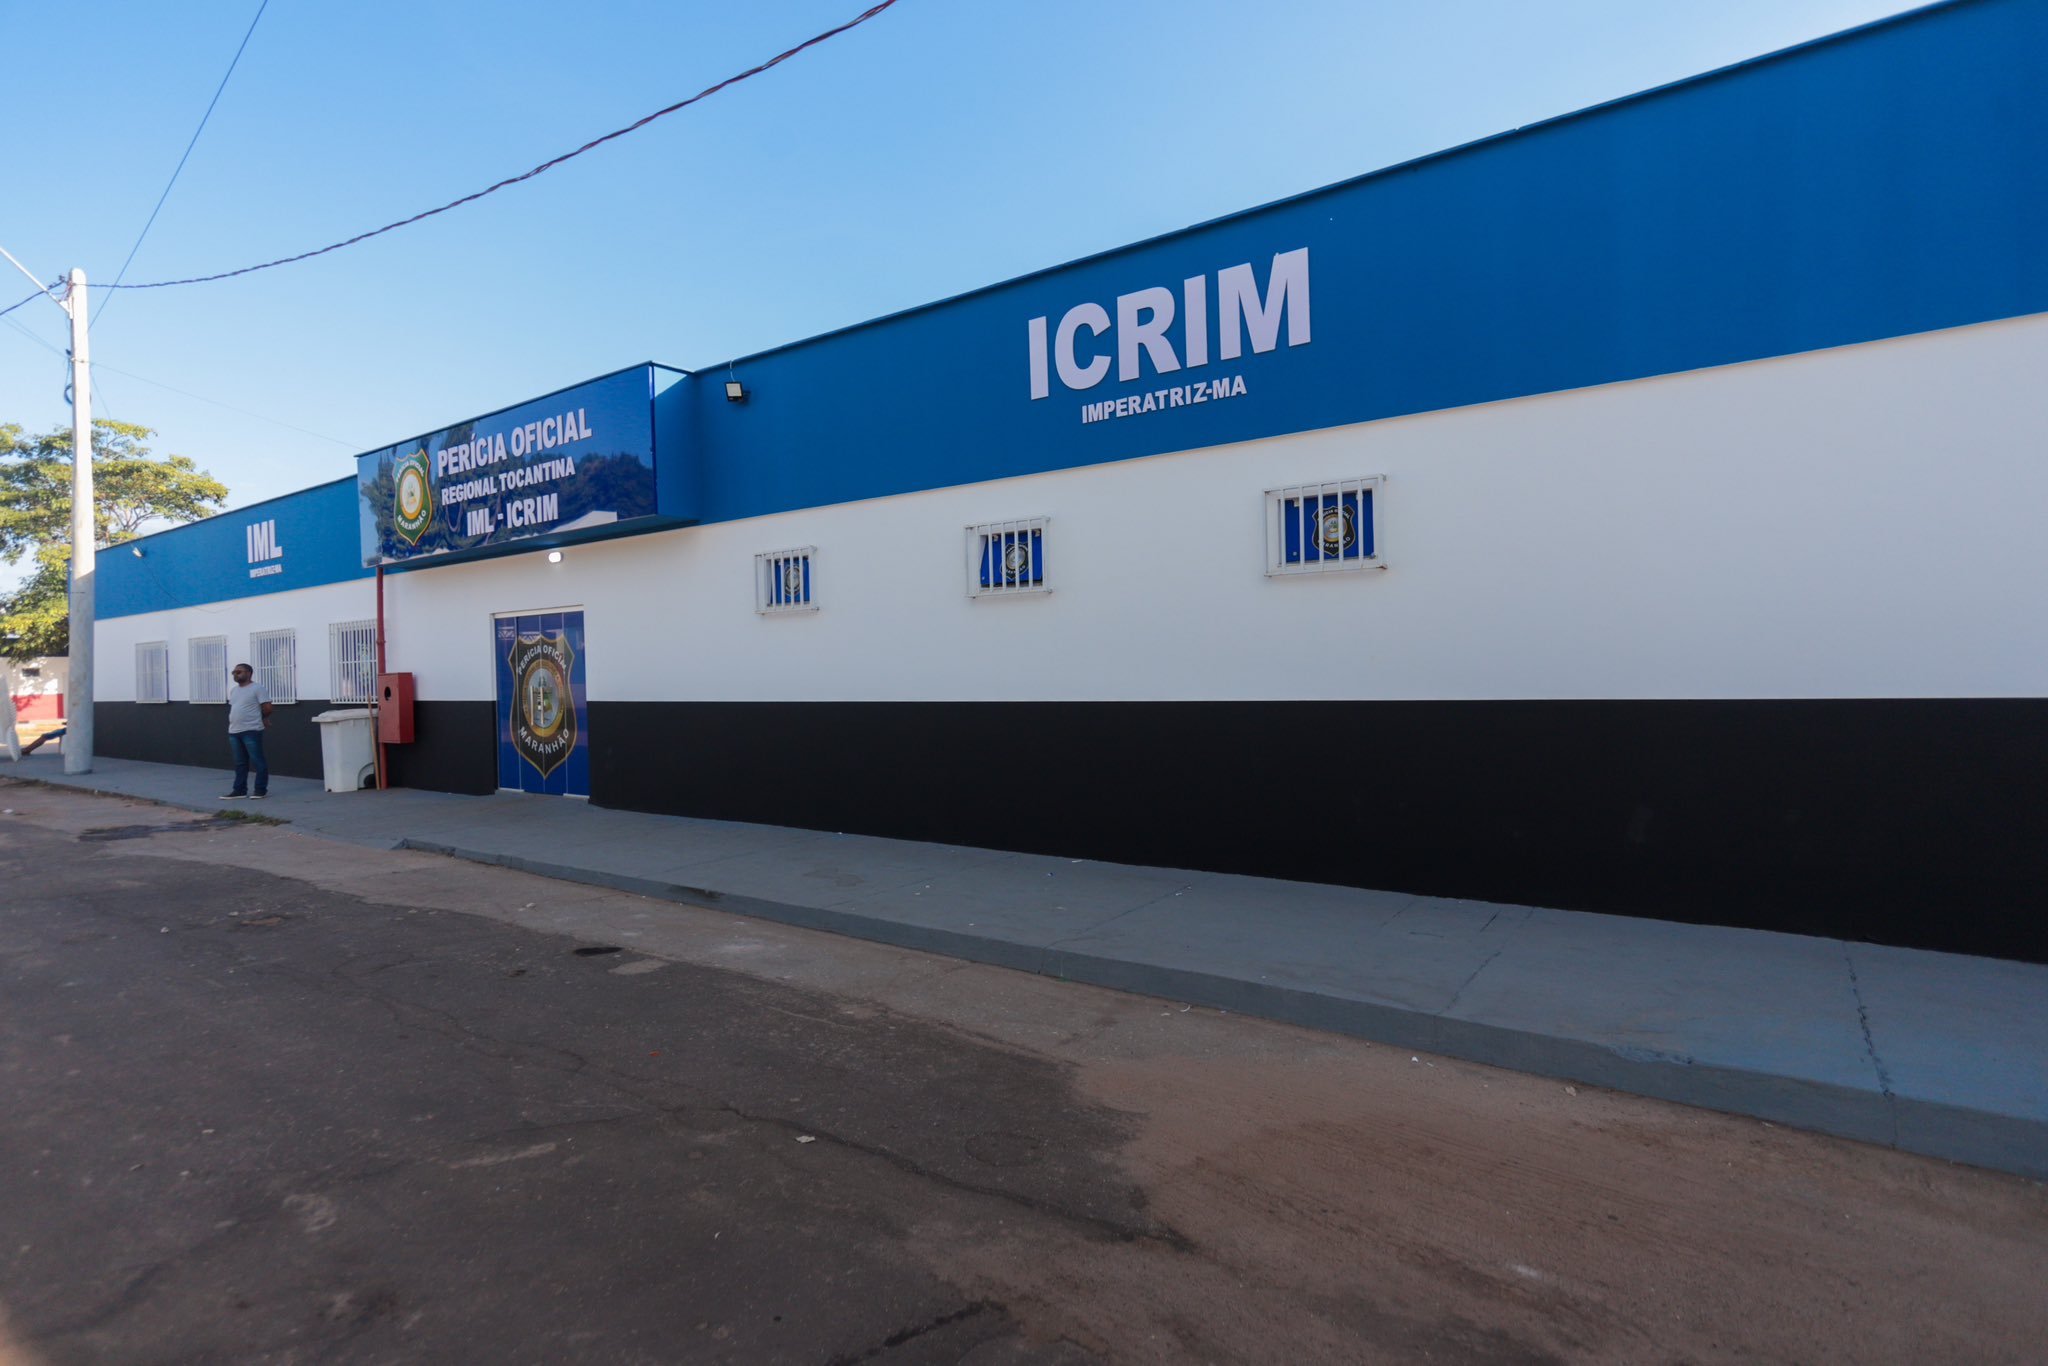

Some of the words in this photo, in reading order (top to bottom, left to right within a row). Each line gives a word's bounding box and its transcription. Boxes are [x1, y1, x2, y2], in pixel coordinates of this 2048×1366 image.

[1028, 247, 1311, 400] ICRIM
[1081, 375, 1247, 424] IMPERATRIZ-MA
[437, 433, 508, 477] PERÍCIA
[510, 408, 592, 457] OFICIAL
[441, 477, 497, 505] REGIONAL
[498, 456, 576, 491] TOCANTINA
[466, 507, 495, 536] IML
[506, 493, 559, 529] ICRIM
[246, 519, 283, 564] IML
[518, 645, 542, 676] PERÍCIA
[519, 726, 570, 754] MARANHÃO
